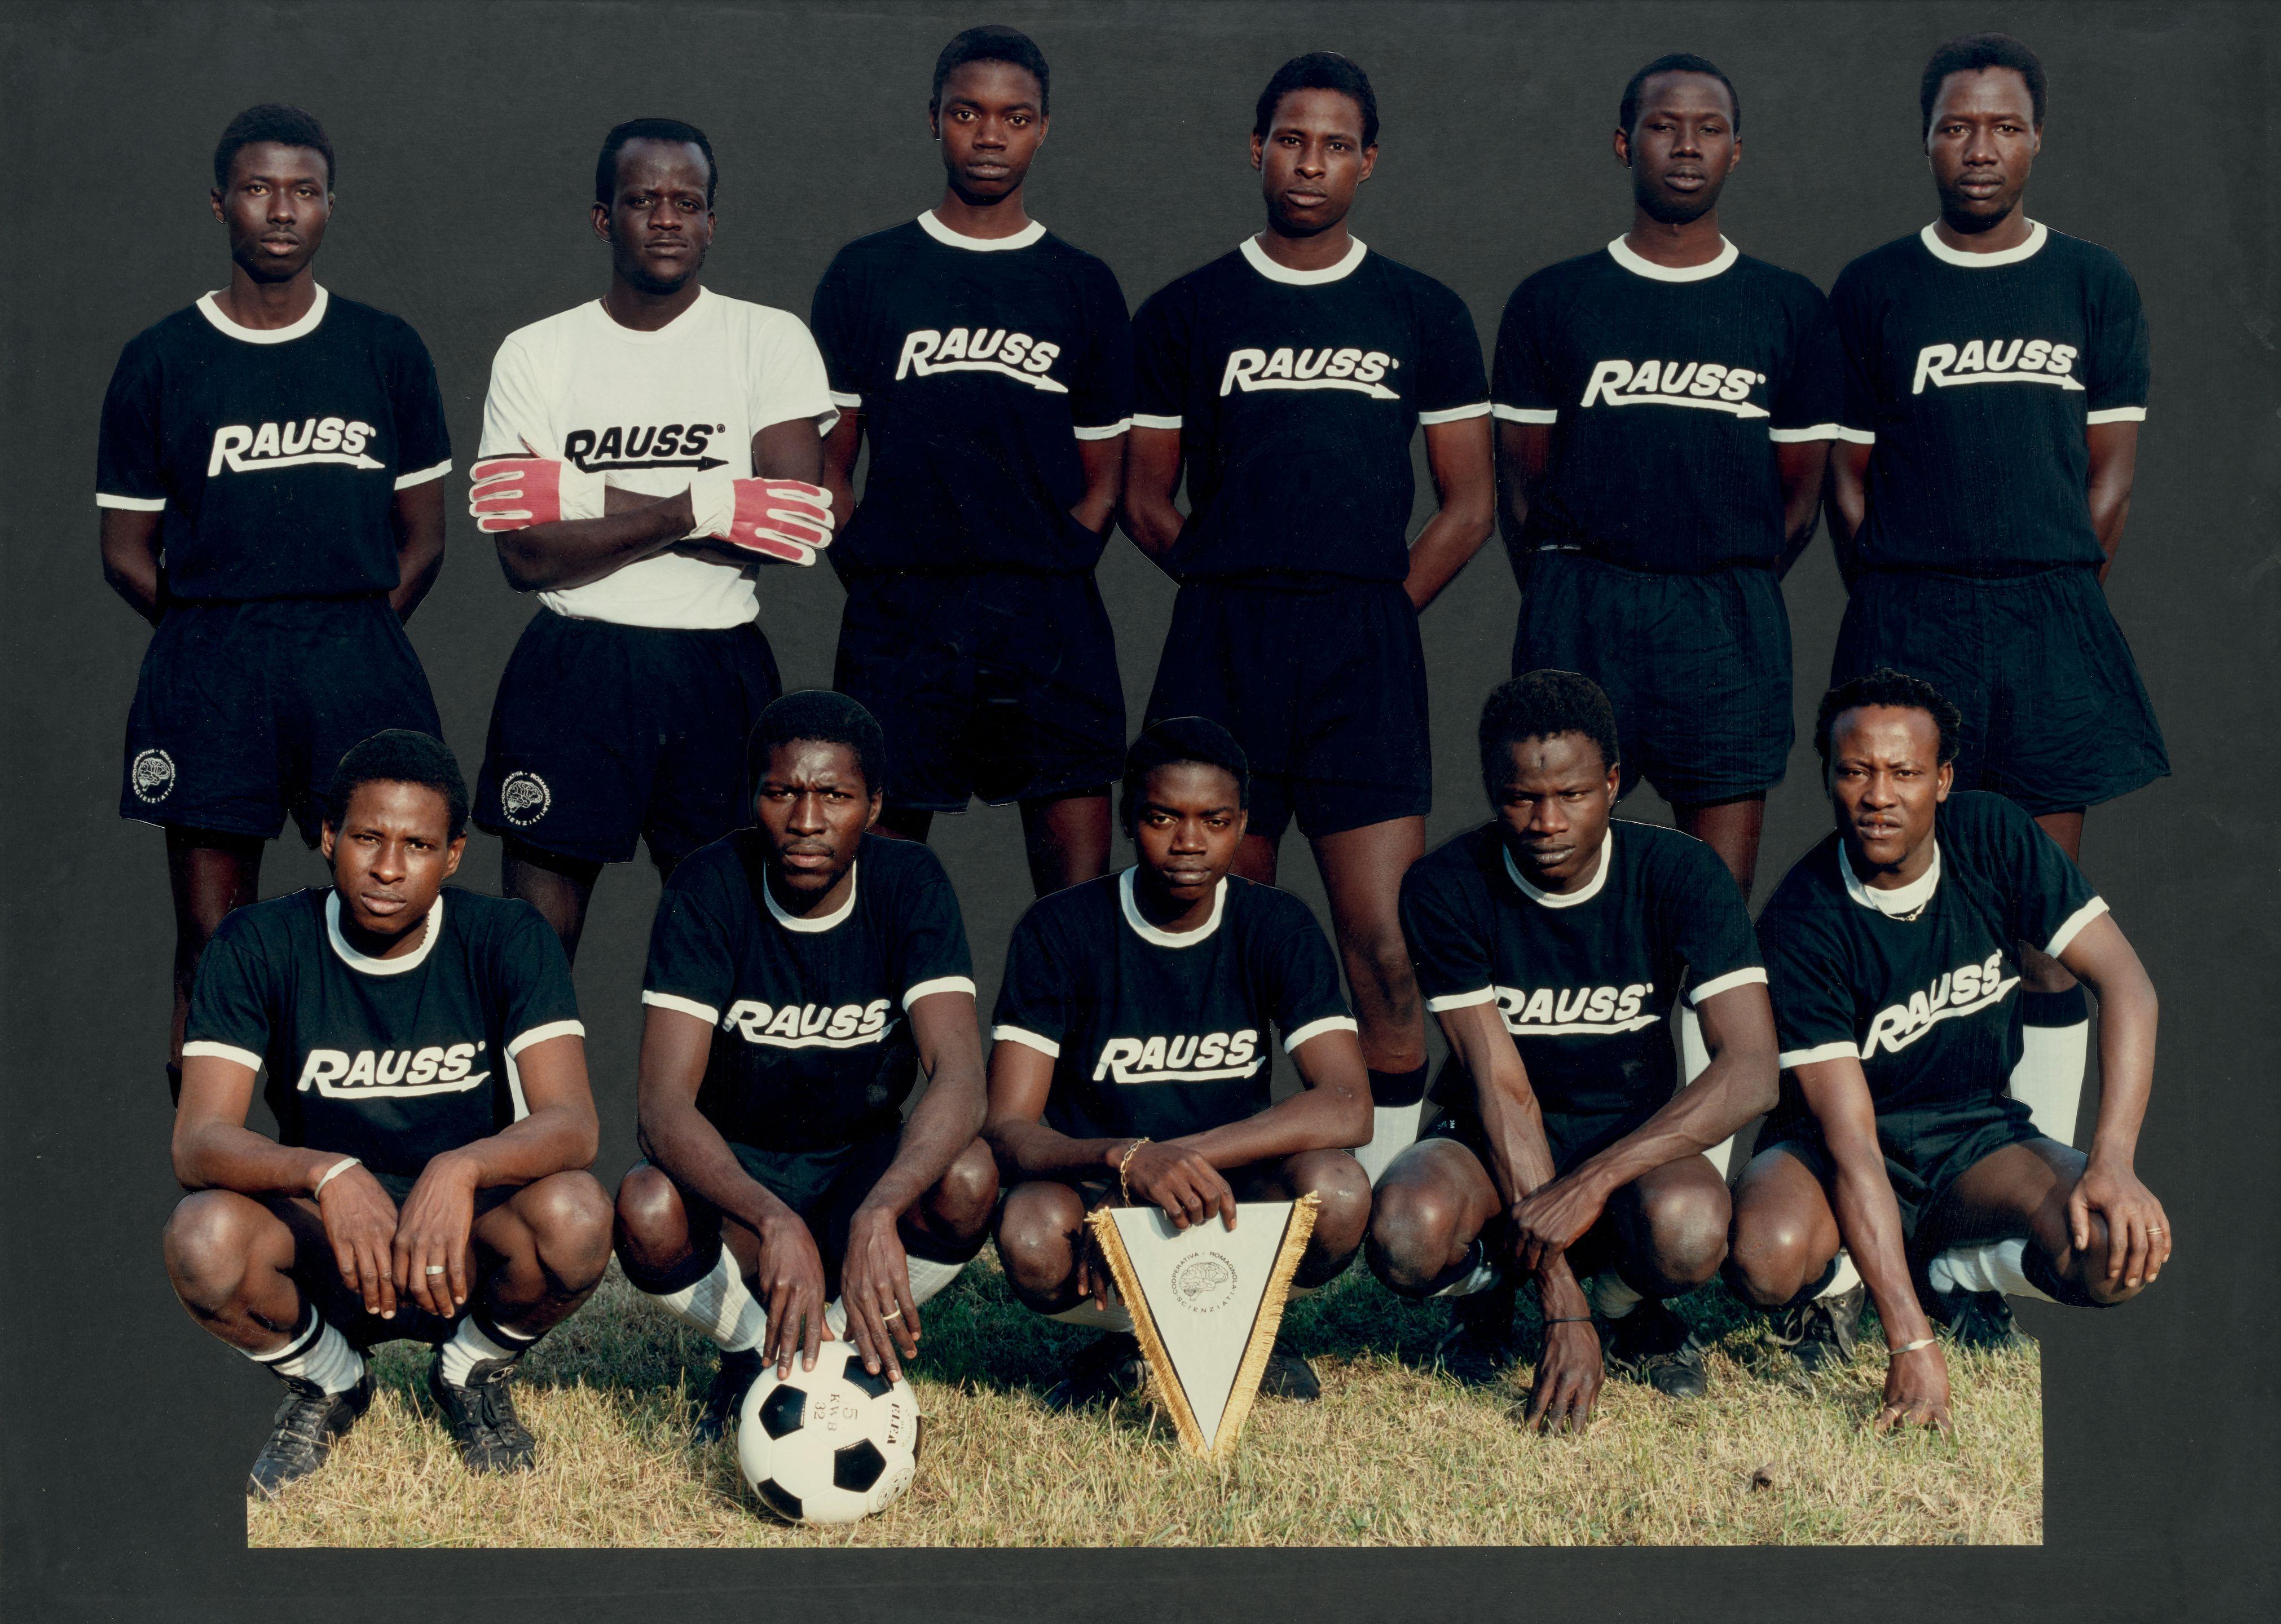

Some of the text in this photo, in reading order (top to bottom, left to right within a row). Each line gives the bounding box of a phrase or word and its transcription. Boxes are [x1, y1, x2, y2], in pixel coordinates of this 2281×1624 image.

[896, 328, 1060, 381] RAUSS
[1220, 348, 1390, 396] RAUSS
[1913, 339, 2078, 394] RAUSS
[1580, 360, 1756, 407] RAUSS
[208, 417, 370, 477] RAUSS
[723, 999, 891, 1048] RAUSS
[1860, 953, 2001, 1060] RAUSS
[297, 1043, 475, 1098] RAUSS
[1093, 1030, 1258, 1083] RAUSS
[1172, 1252, 1199, 1295] COOPERATIVA
[1177, 1292, 1235, 1313] SCIENZIATI
[814, 1402, 826, 1419] 32
[843, 1407, 858, 1420] 5
